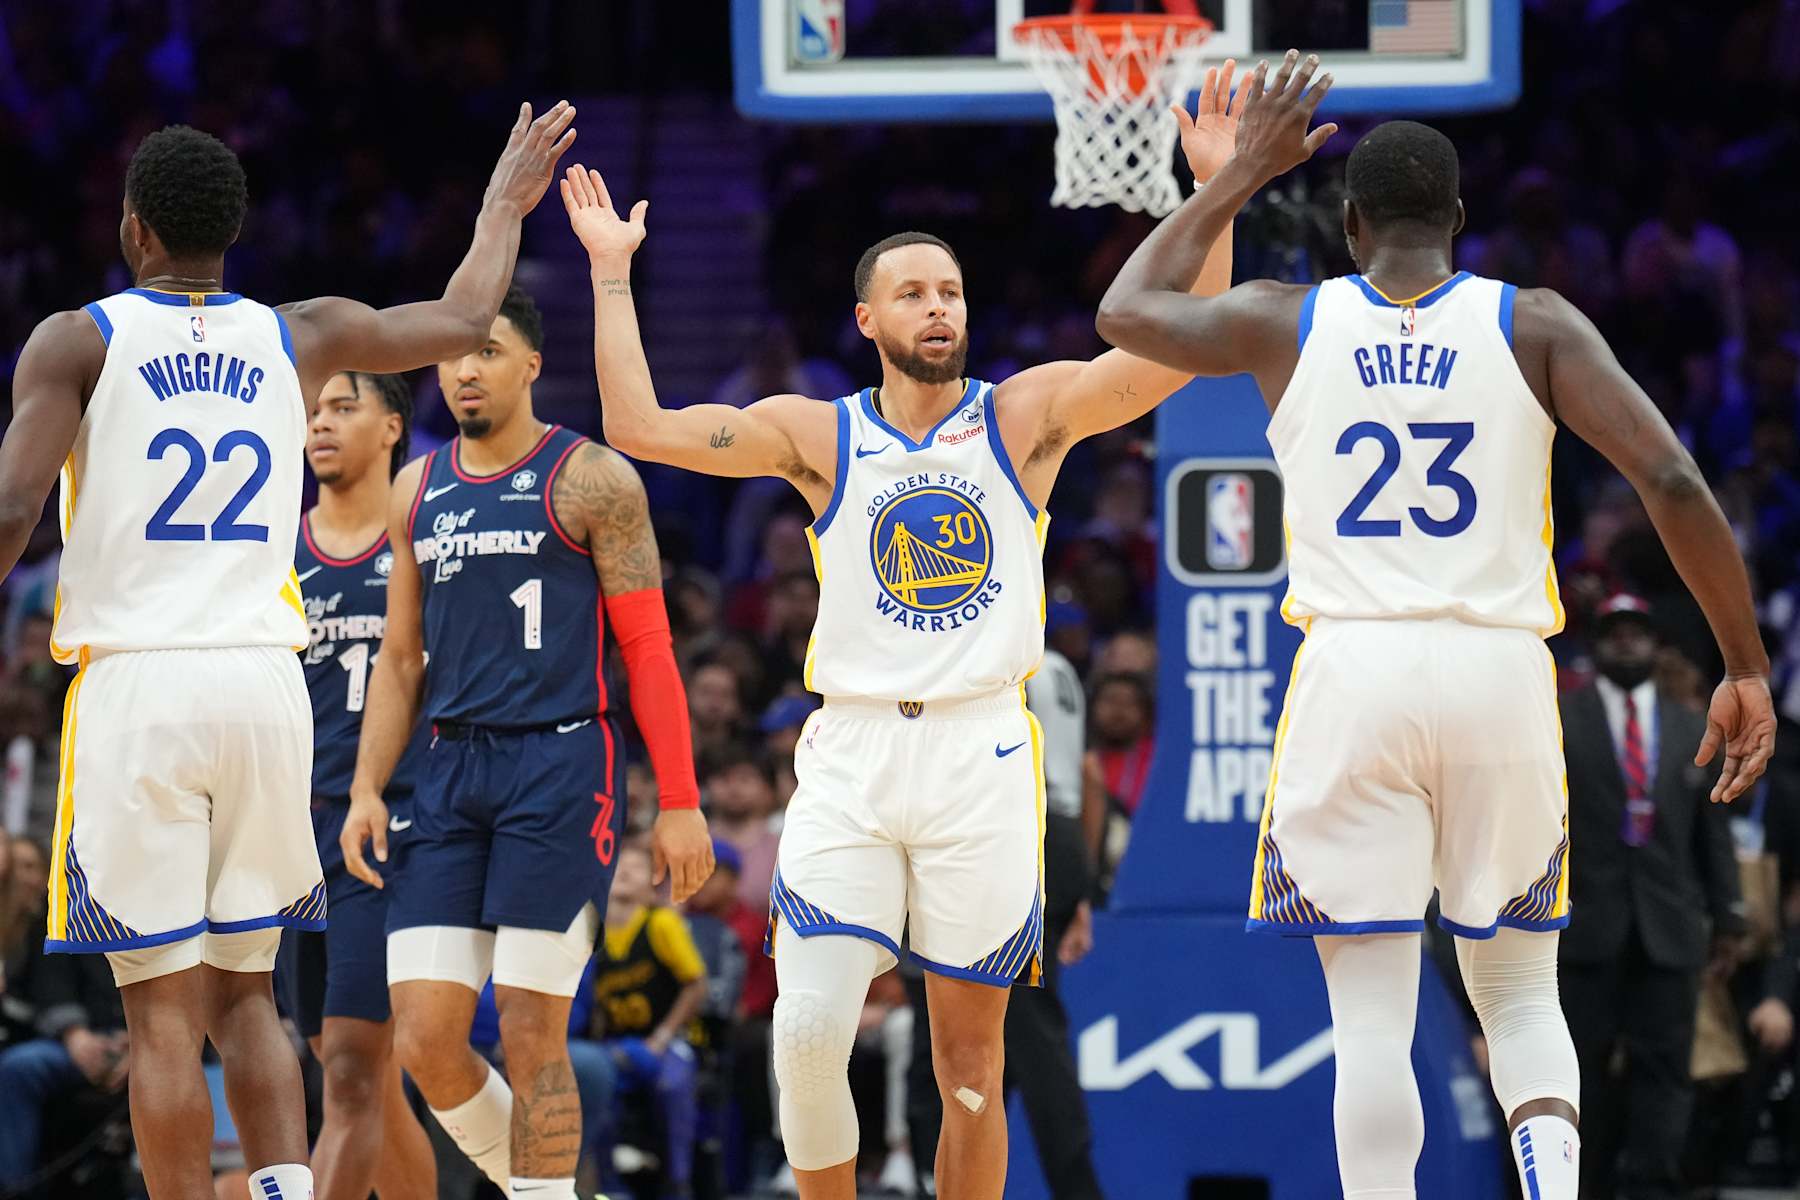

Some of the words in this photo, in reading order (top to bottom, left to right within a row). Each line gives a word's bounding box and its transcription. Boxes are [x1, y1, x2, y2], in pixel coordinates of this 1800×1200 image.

[138, 352, 265, 404] WIGGINS
[1354, 343, 1458, 390] GREEN
[937, 425, 984, 445] Rakuten
[145, 428, 271, 542] 22
[867, 473, 929, 518] GOLDEN
[938, 473, 986, 504] STATE
[1335, 421, 1477, 538] 23
[413, 530, 546, 564] BROTHERLY
[931, 511, 977, 549] 30
[307, 614, 388, 643] OTHER
[509, 579, 542, 650] 1
[875, 578, 1002, 632] WARRIORS
[1187, 592, 1274, 669] GET
[1185, 670, 1276, 746] THE
[1184, 748, 1273, 823] APP
[590, 792, 615, 867] 76
